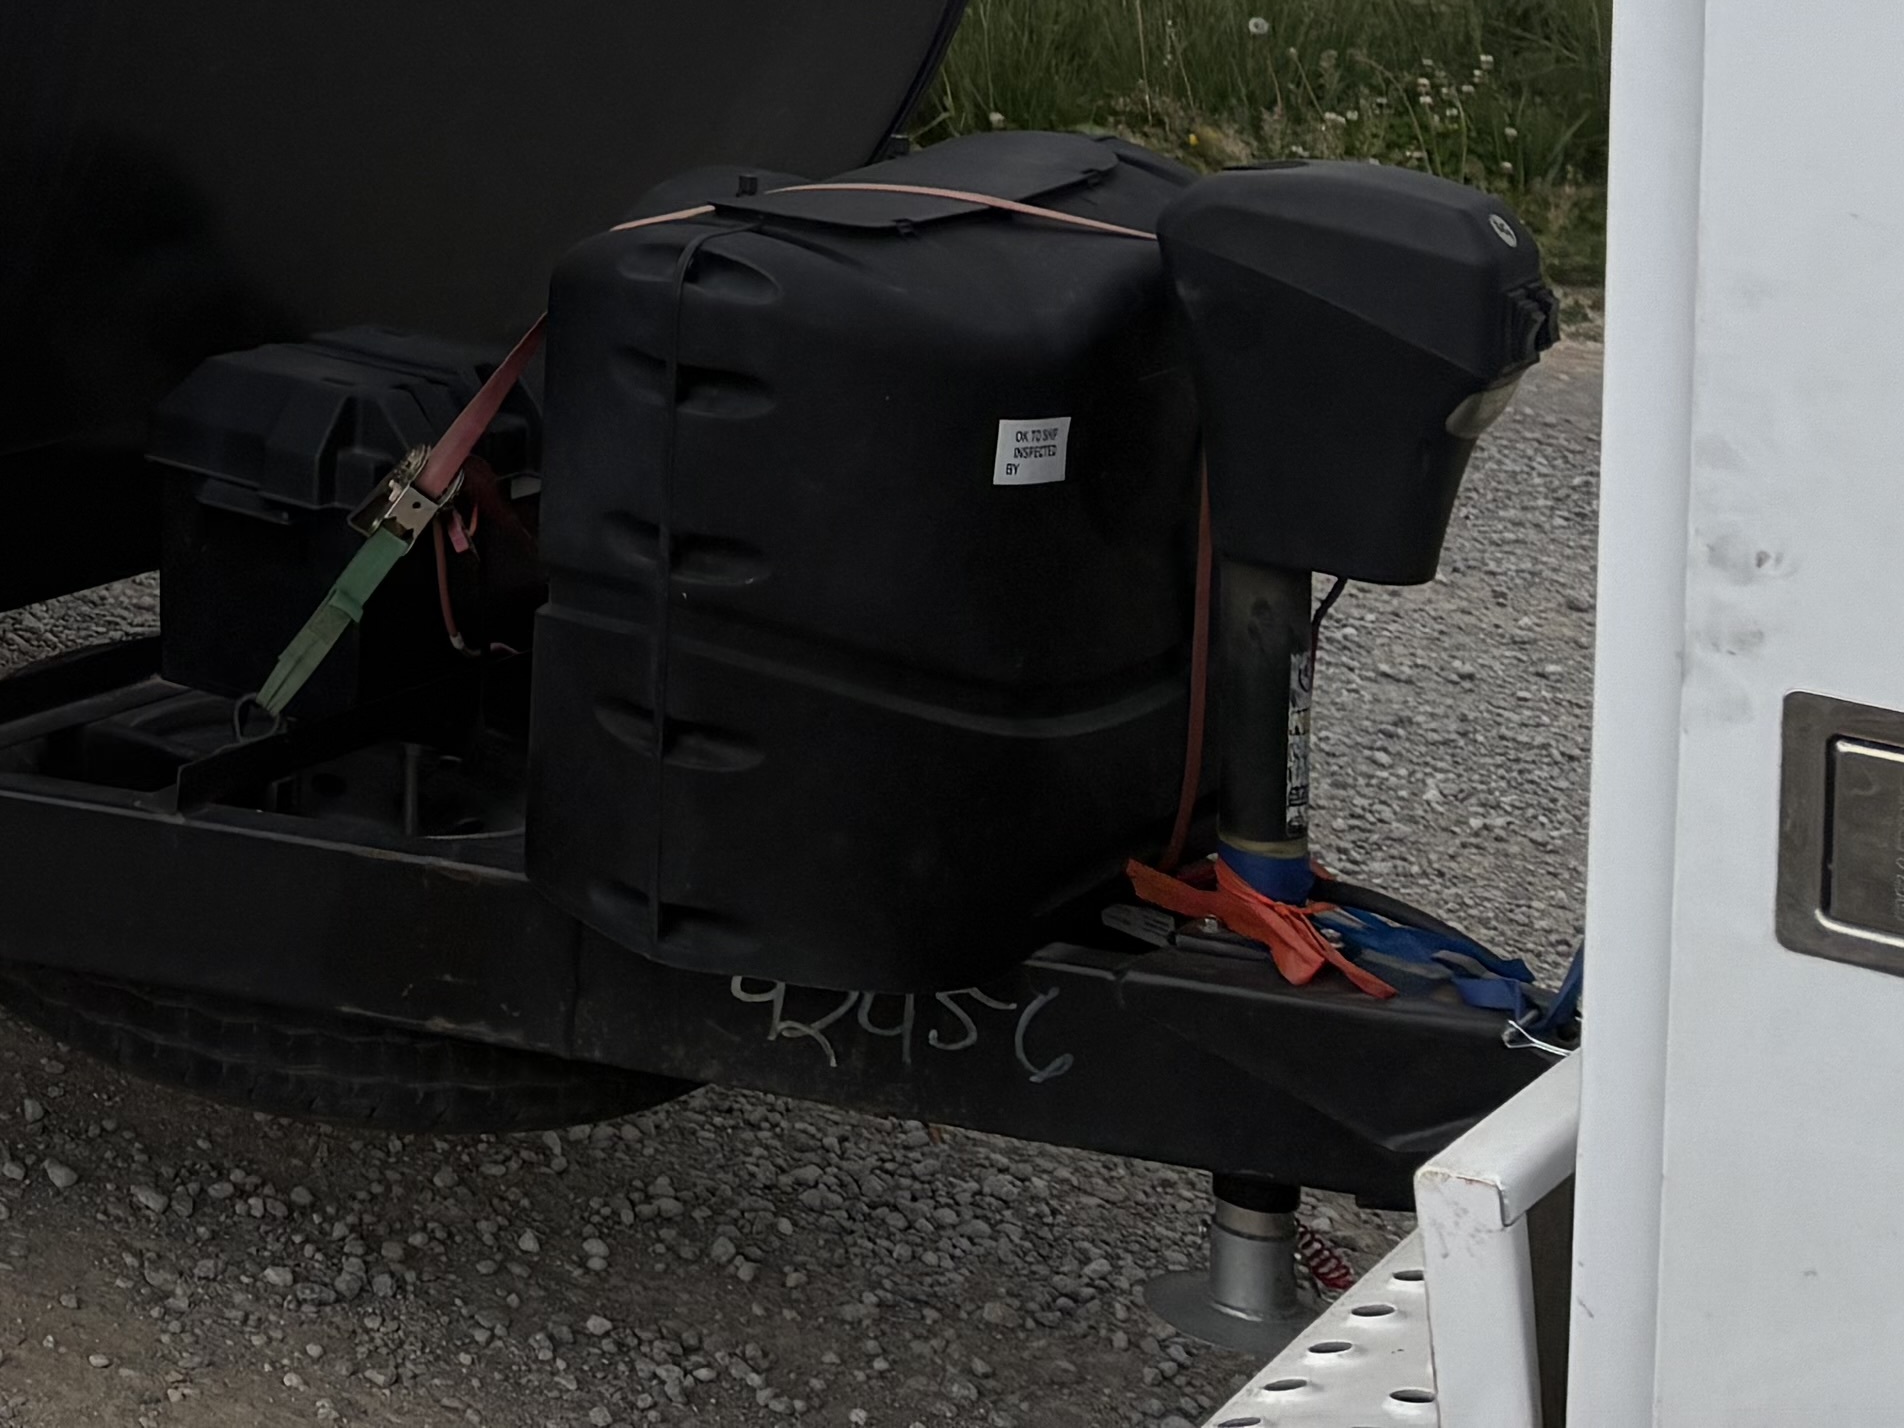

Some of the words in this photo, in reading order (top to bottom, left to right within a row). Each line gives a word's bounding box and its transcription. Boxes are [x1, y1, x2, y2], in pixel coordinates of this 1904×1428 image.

[1015, 430, 1029, 443] OK
[1031, 429, 1042, 442] TO
[1013, 444, 1058, 459] INSPECTED
[1005, 462, 1021, 476] BY
